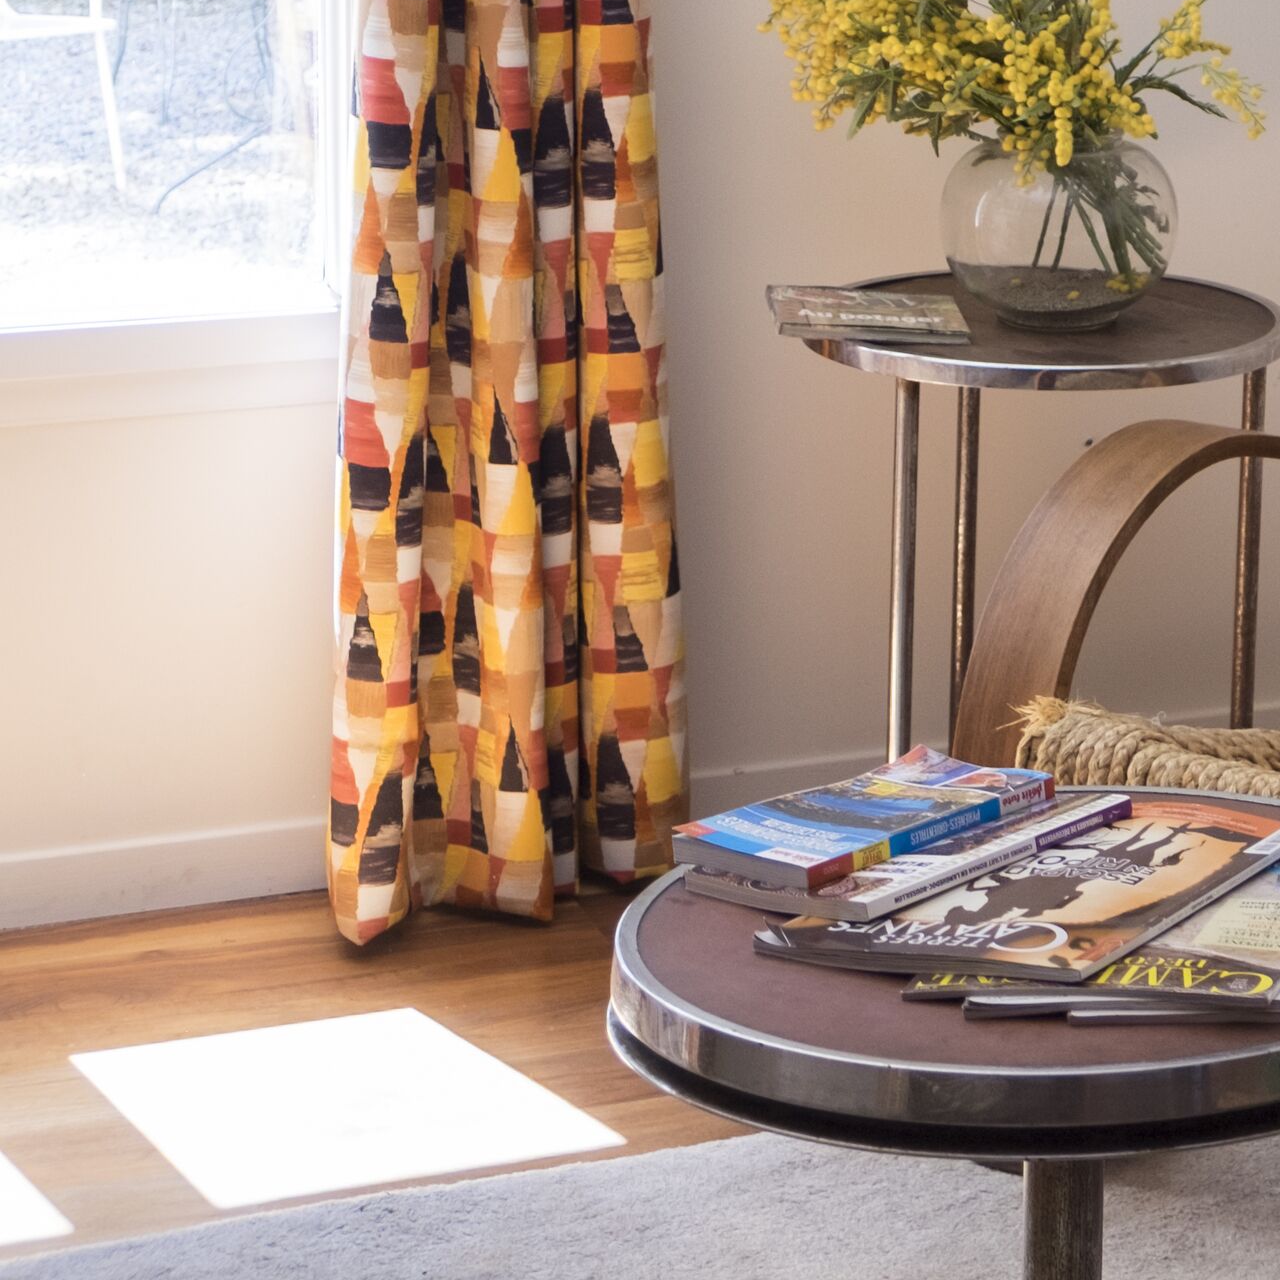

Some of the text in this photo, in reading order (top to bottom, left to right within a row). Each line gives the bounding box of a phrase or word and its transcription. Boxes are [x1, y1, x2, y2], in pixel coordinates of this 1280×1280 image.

[798, 308, 945, 324] Au potager
[1004, 865, 1143, 886] ESCAPAD
[873, 934, 974, 948] TERRES
